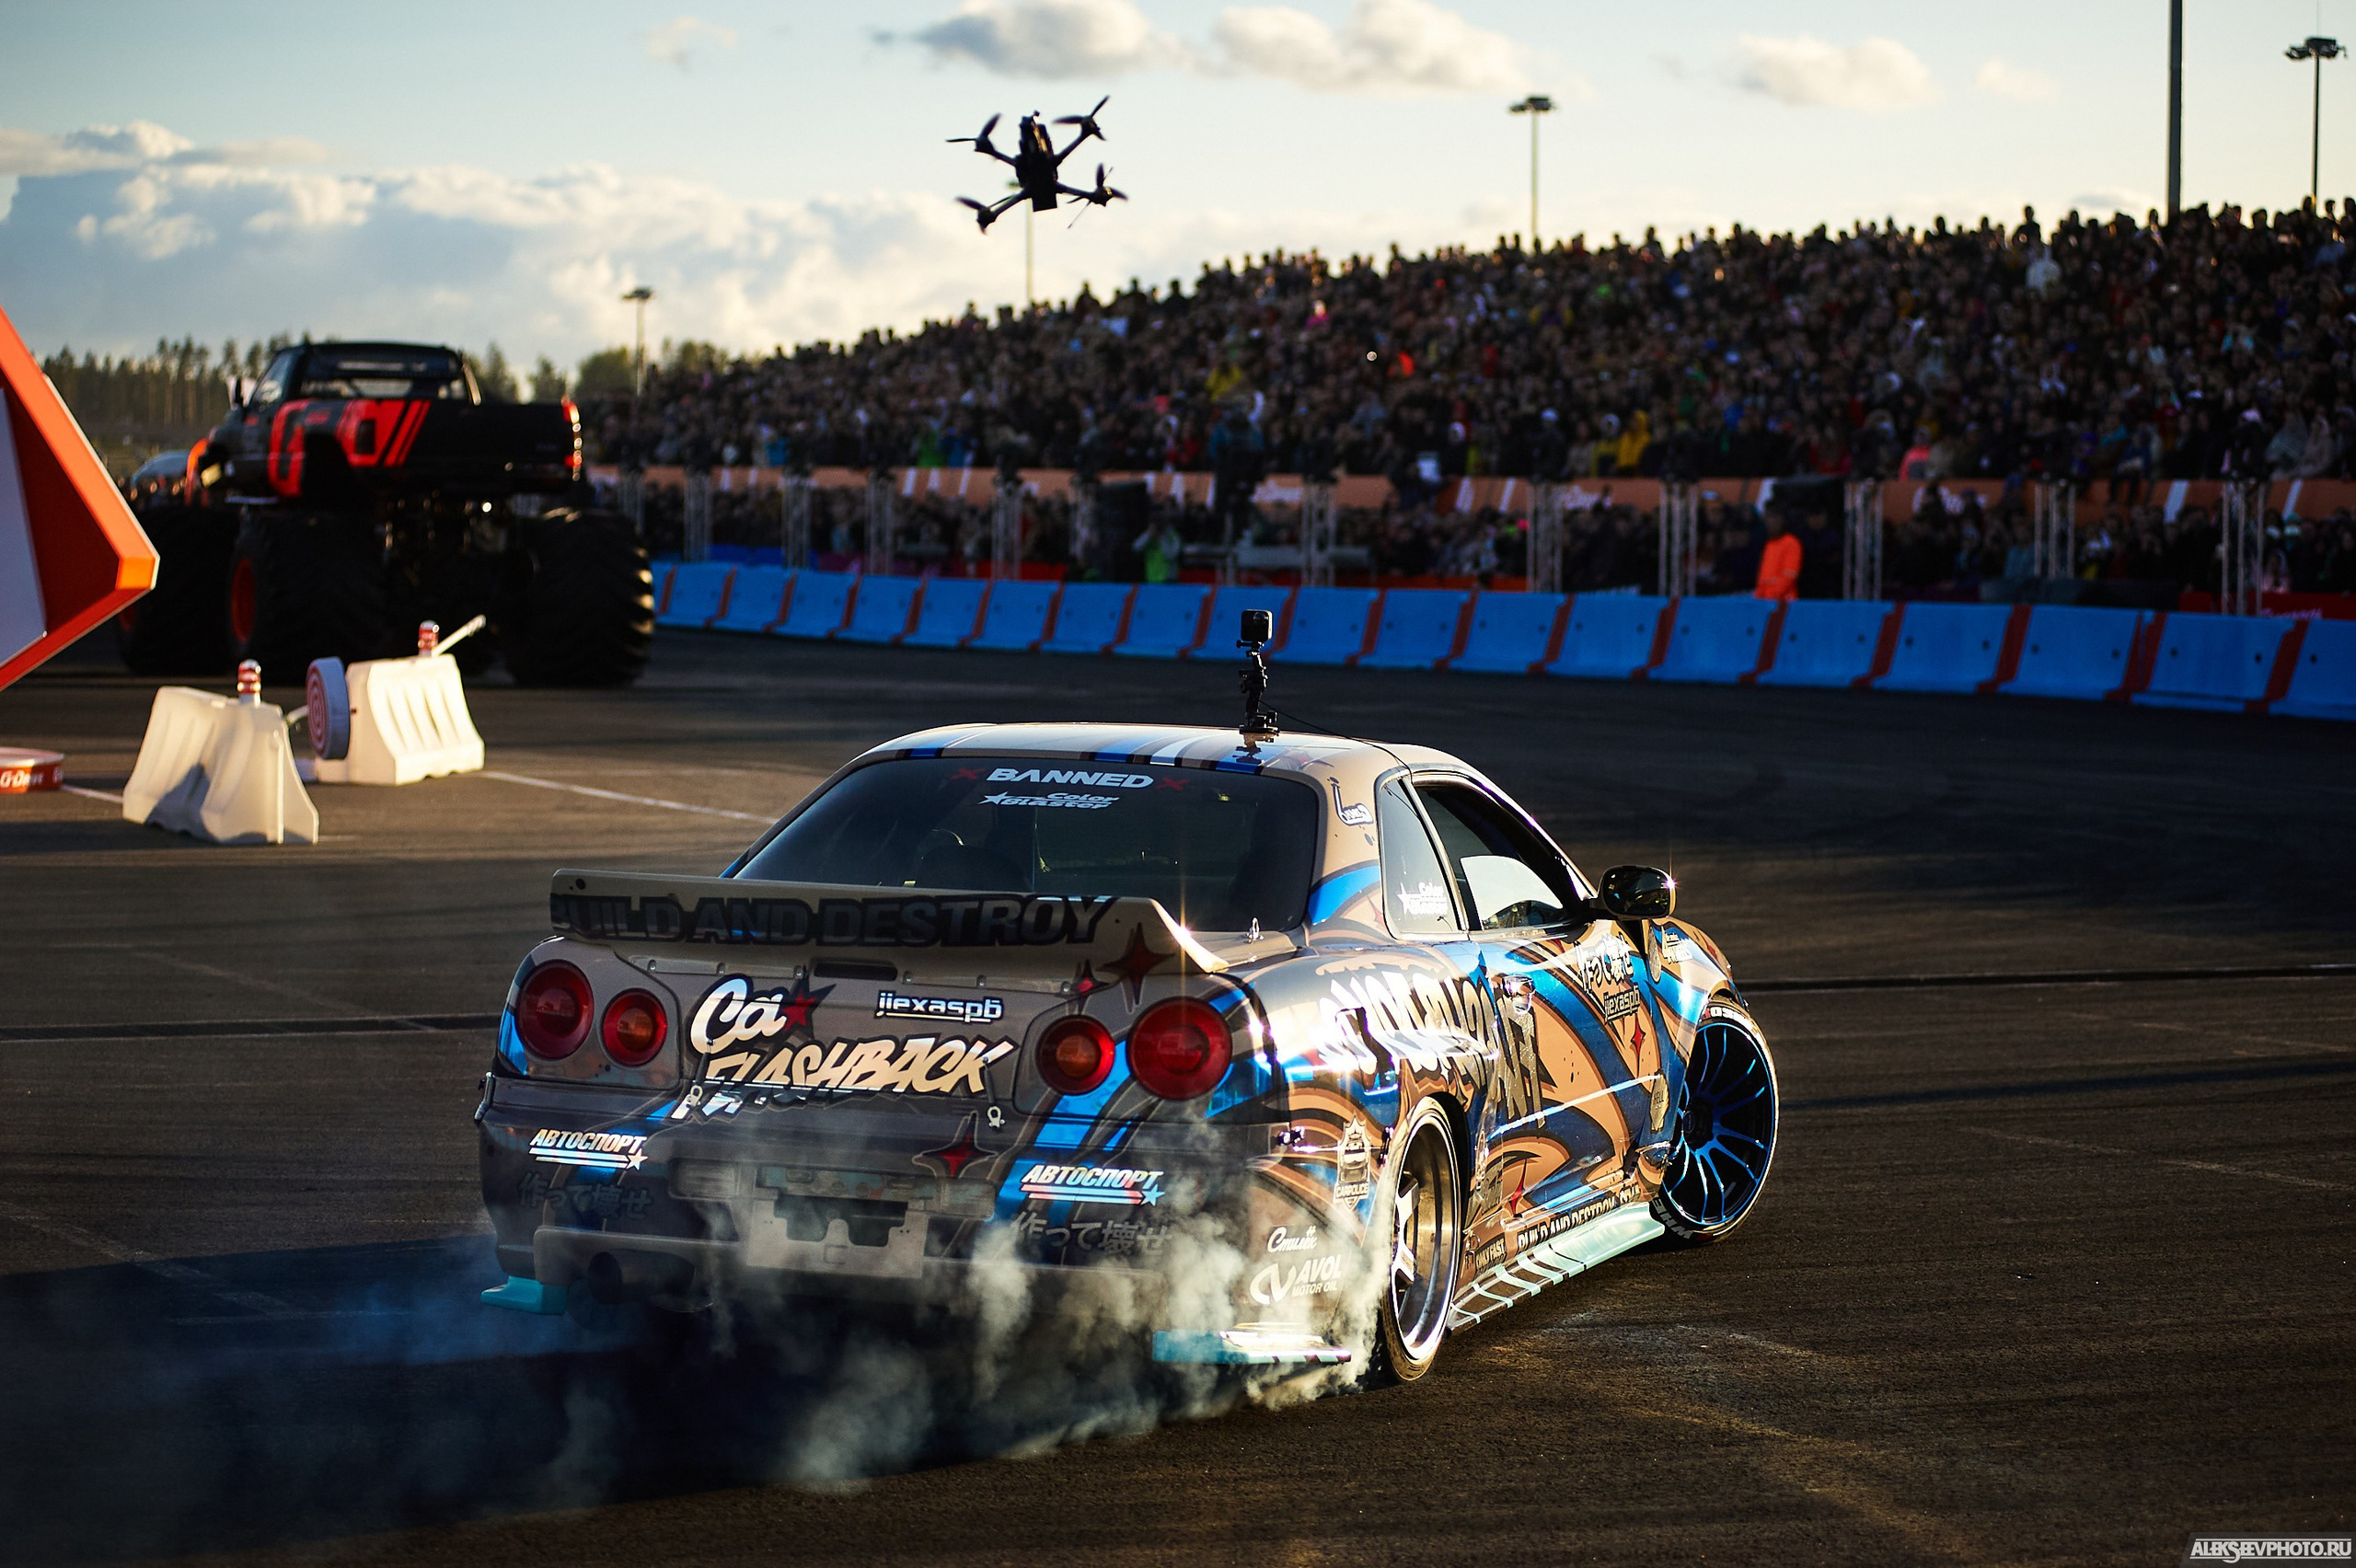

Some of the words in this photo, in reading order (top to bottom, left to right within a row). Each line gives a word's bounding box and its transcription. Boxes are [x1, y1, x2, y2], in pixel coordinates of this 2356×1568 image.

[987, 767, 1154, 789] BANNED
[999, 798, 1112, 810] Blaster
[1046, 792, 1120, 803] Color
[688, 898, 812, 944] AND
[817, 894, 1114, 947] DESTROY
[530, 1128, 648, 1154] АВТОСПОРТ
[1021, 1164, 1164, 1190] АВТОСПОРТ
[1010, 1211, 1172, 1257] 作って壊せ
[1295, 1253, 1342, 1286] AVOL
[1291, 1282, 1323, 1297] MOTOR
[1322, 1280, 1339, 1293] OIL
